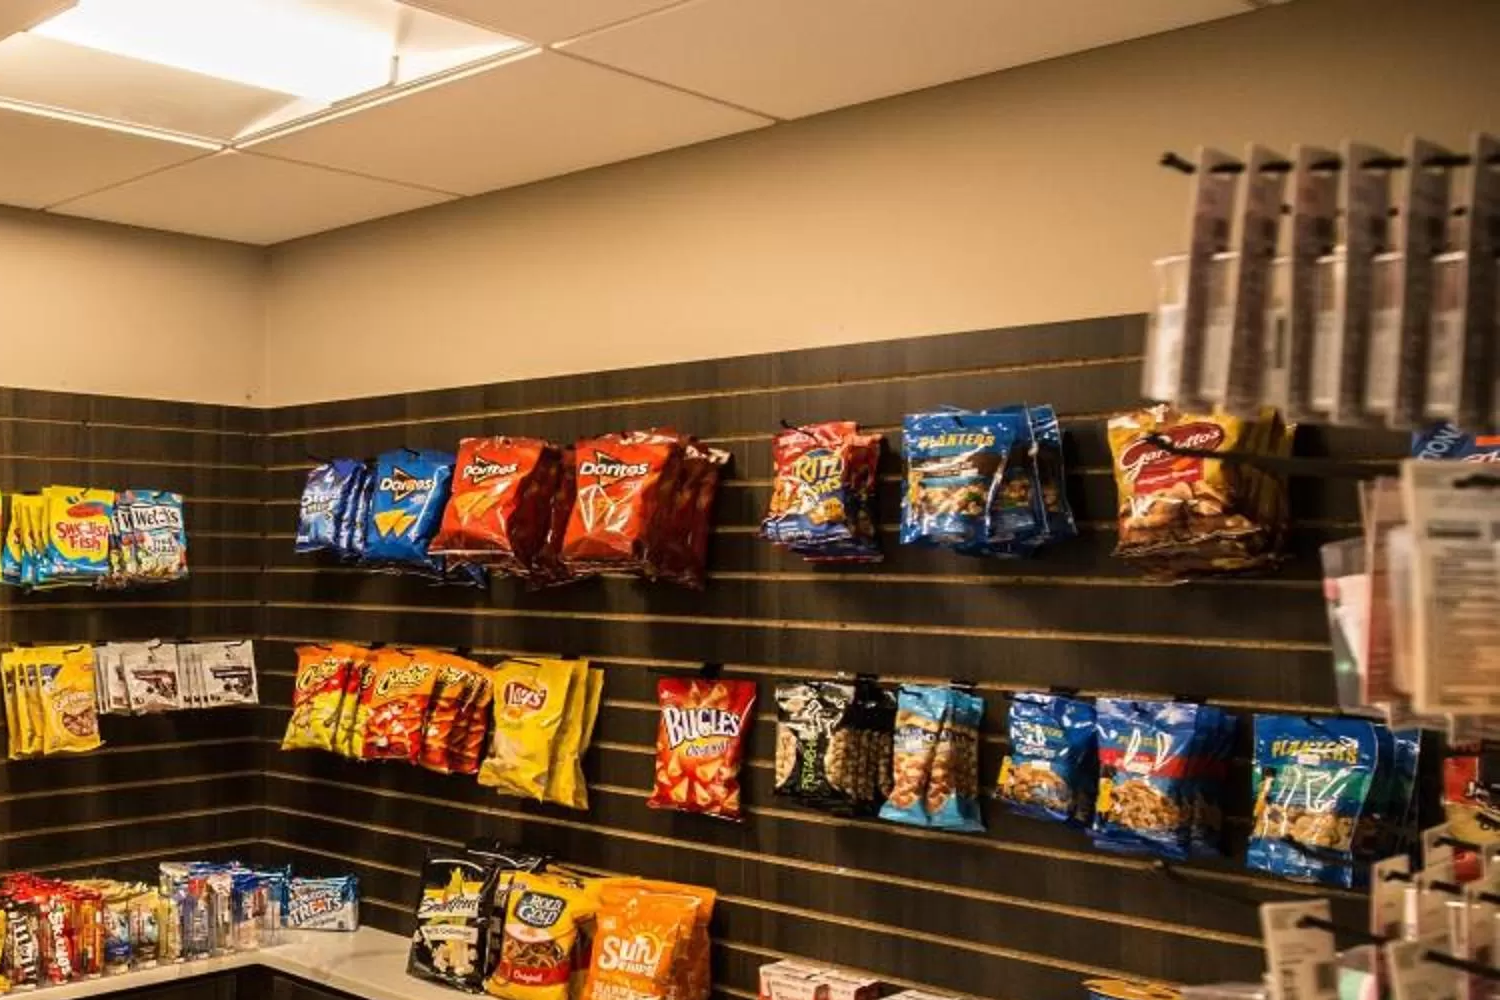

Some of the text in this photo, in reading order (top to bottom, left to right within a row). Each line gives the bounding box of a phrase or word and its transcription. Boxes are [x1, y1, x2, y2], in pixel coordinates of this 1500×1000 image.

[579, 461, 648, 475] Doritos
[134, 508, 179, 526] Wel's
[56, 521, 109, 538] Swish
[663, 706, 740, 748] BUGLES
